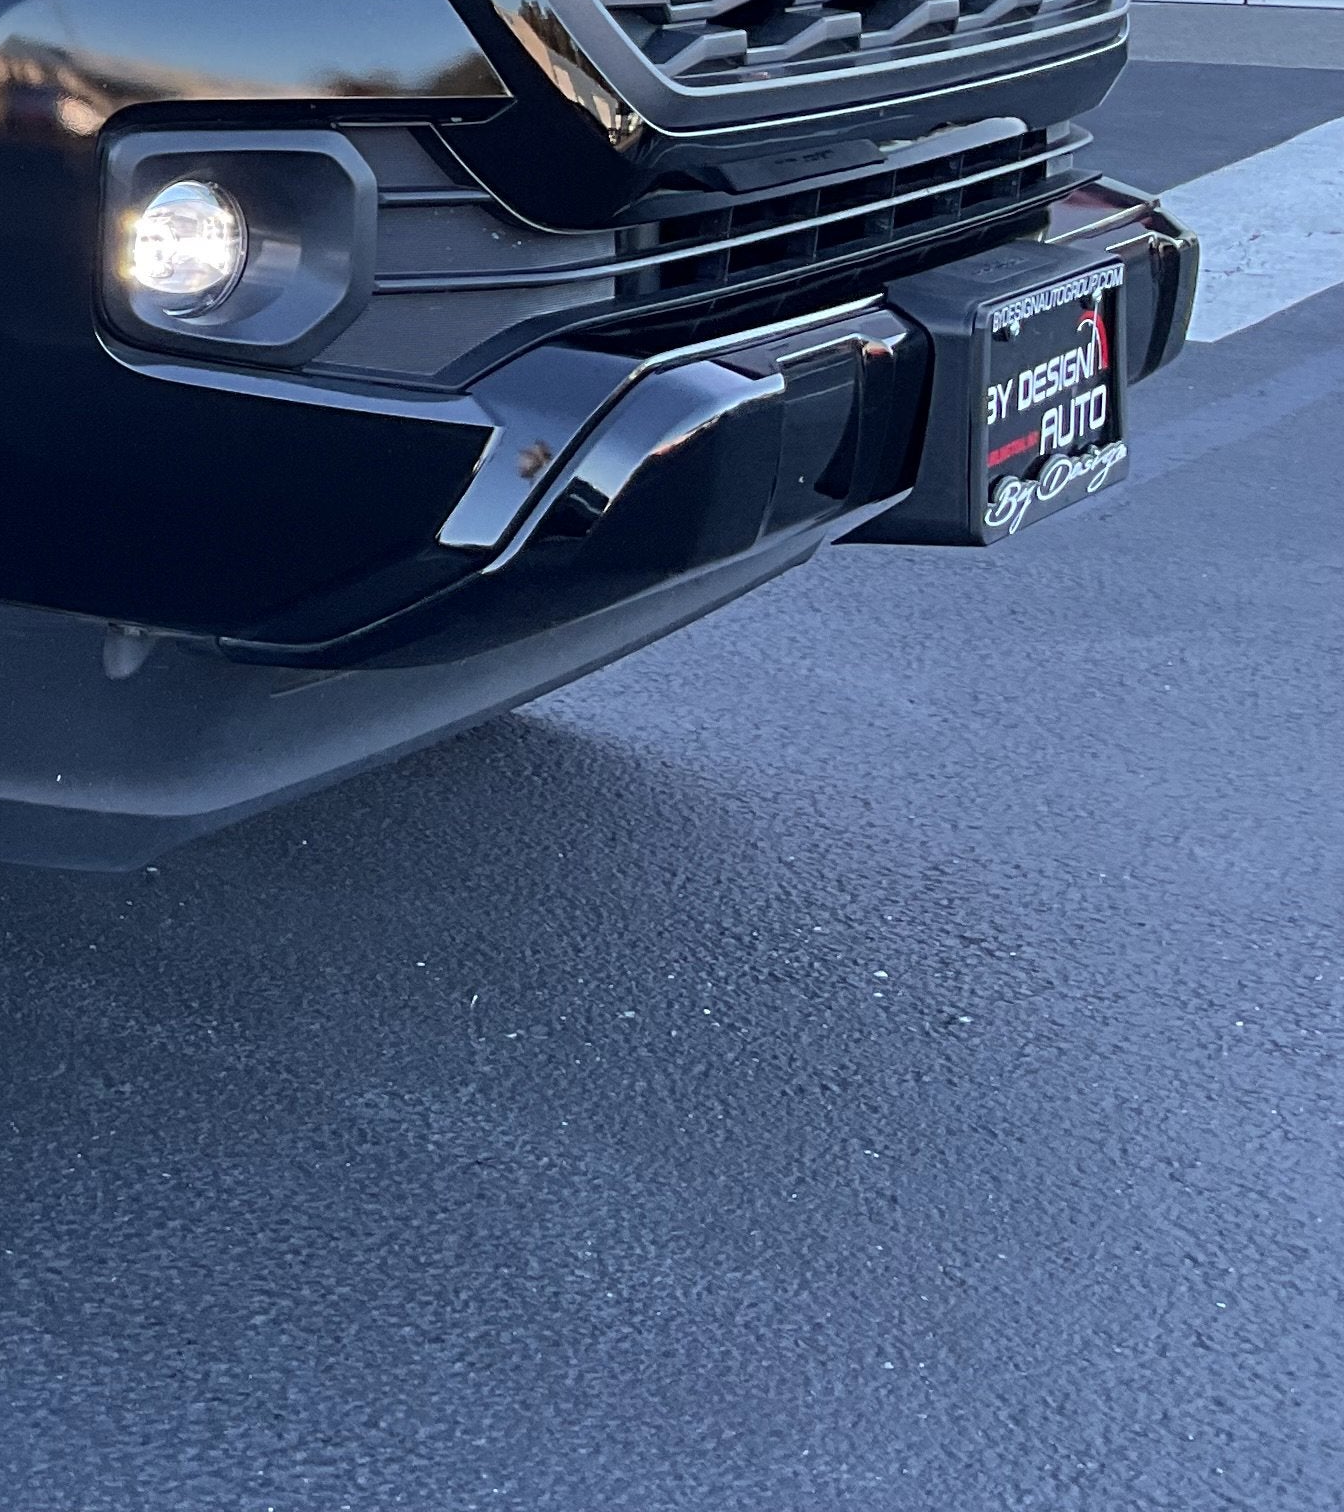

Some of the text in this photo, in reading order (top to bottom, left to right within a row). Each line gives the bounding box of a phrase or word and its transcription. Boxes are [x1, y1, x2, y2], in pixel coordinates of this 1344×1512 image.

[987, 342, 1095, 426] BY DESIGN
[1040, 384, 1108, 456] AUTO
[984, 476, 1040, 535] By
[1036, 442, 1128, 501] Design
